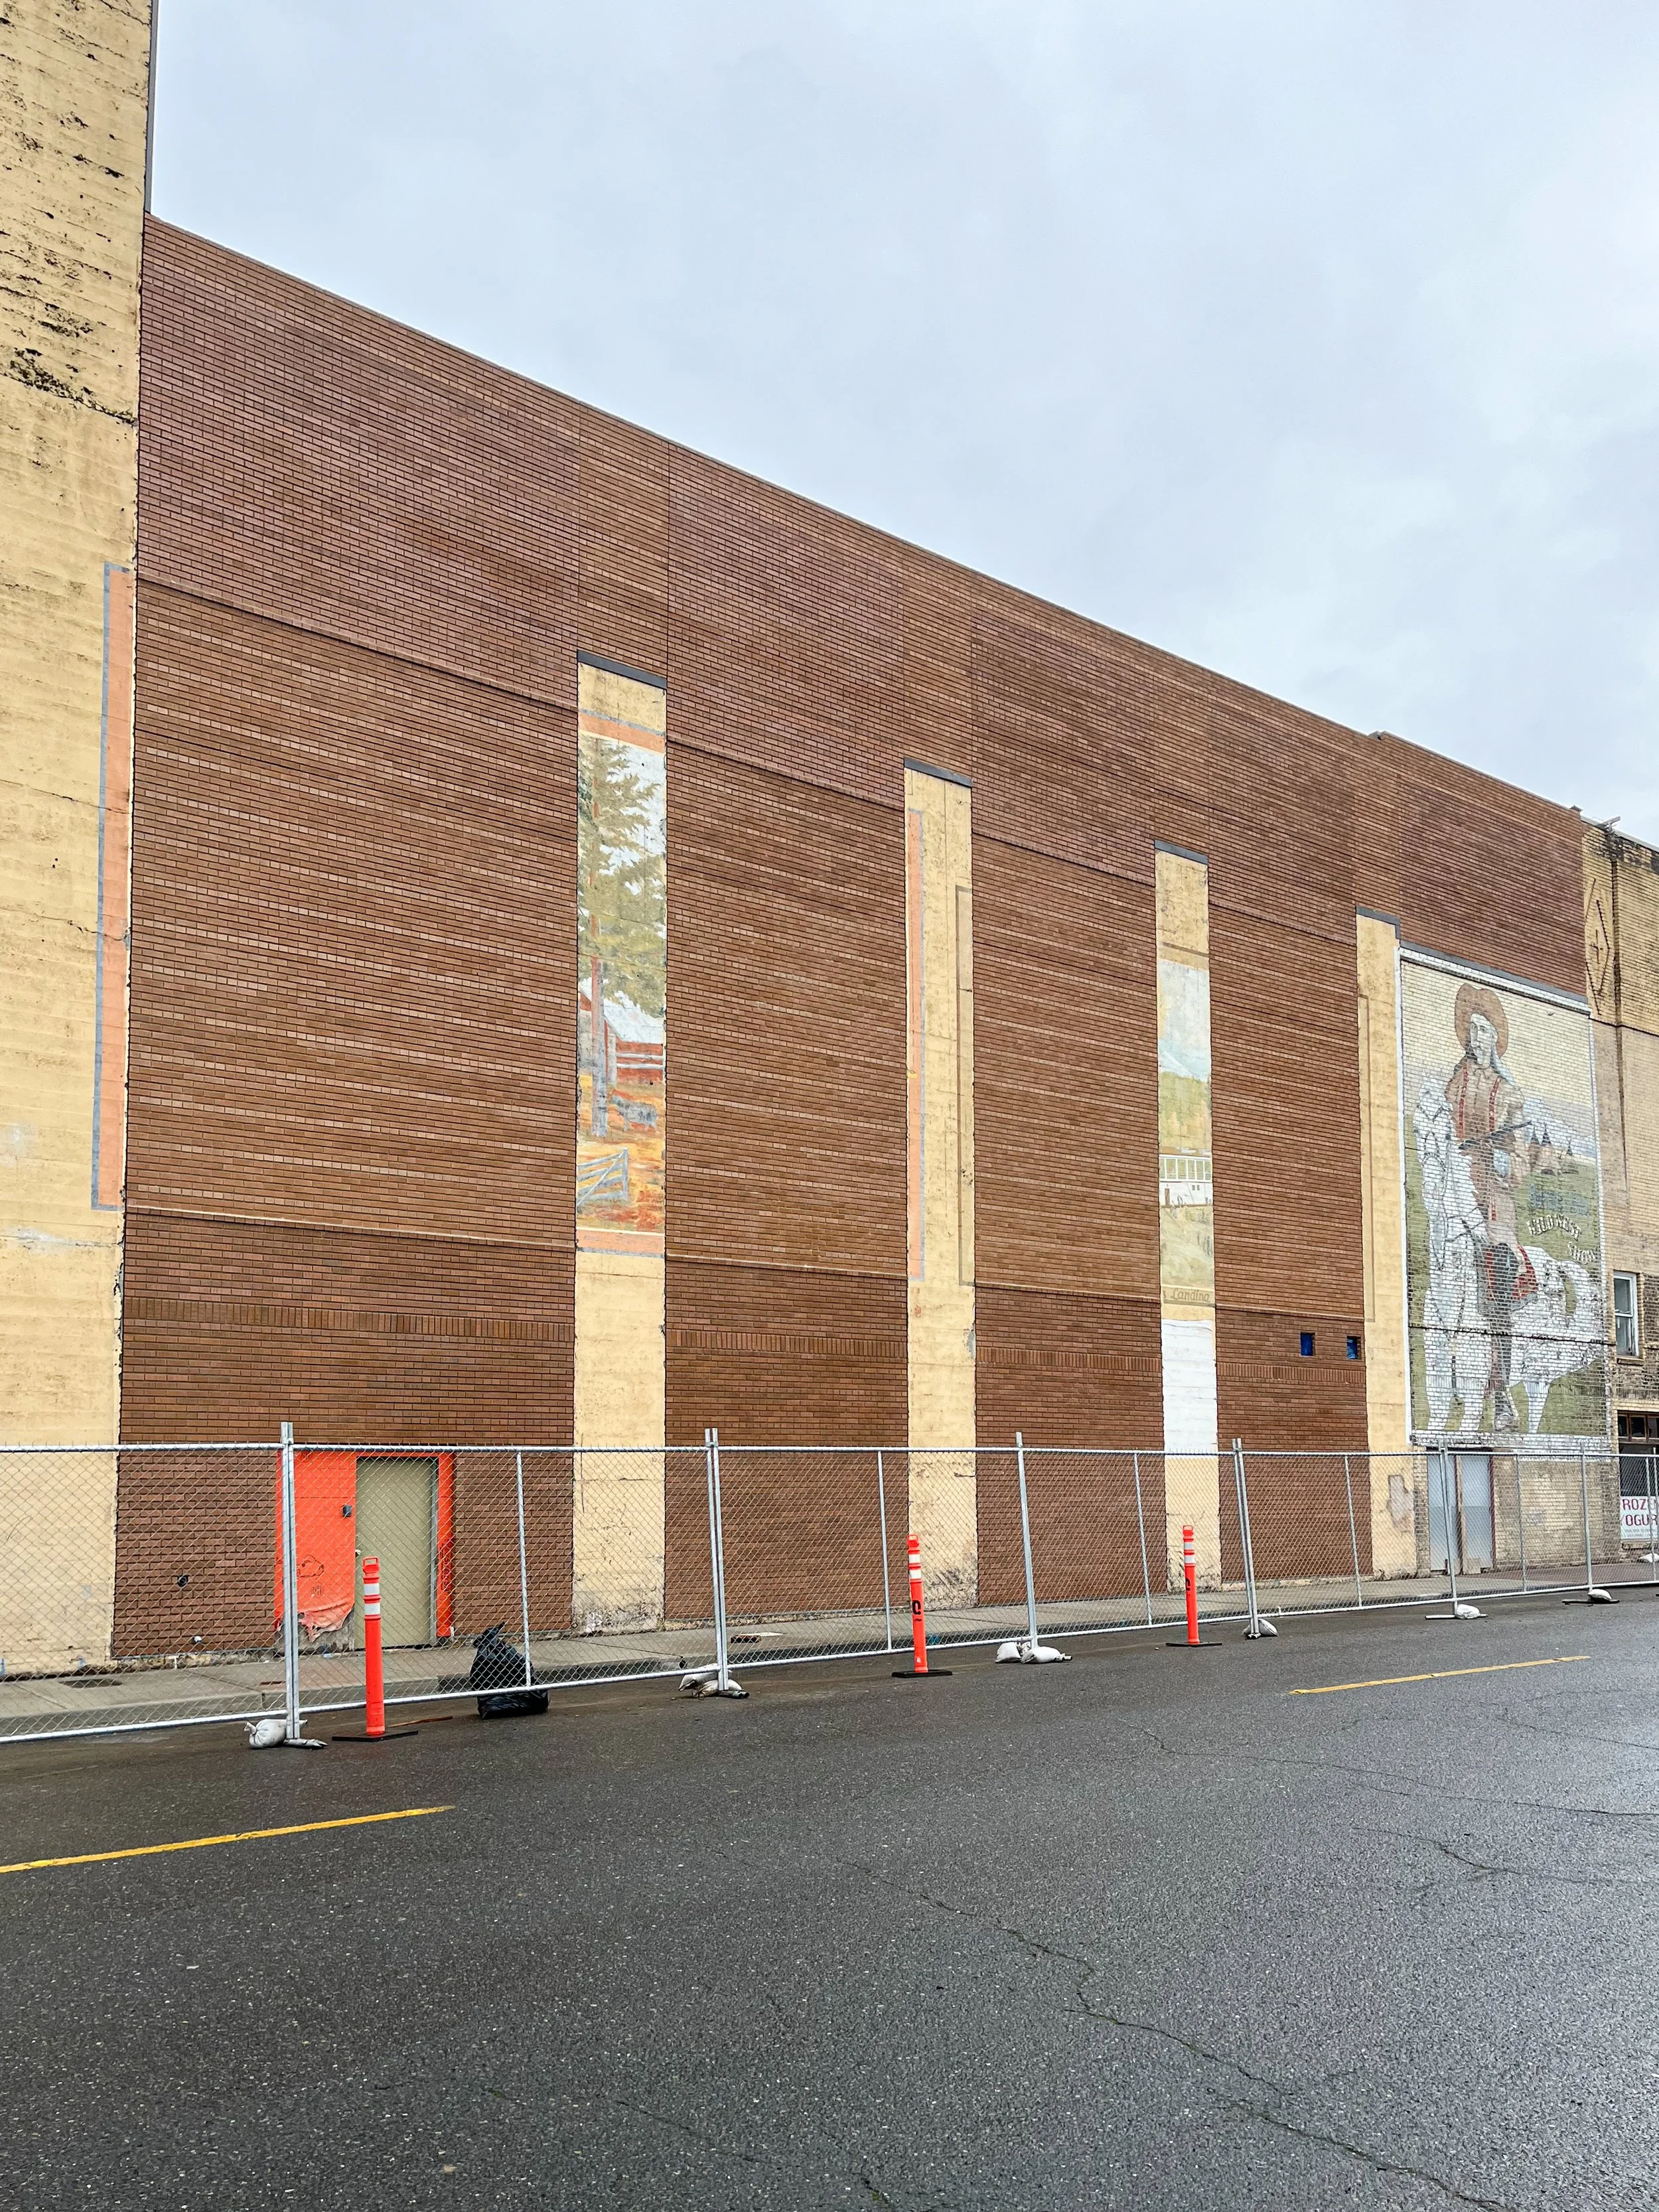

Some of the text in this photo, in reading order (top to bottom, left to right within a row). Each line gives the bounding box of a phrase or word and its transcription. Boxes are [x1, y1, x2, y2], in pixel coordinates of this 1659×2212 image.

[1526, 1214, 1582, 1242] WILD WEST
[1567, 1242, 1599, 1265] SHOW
